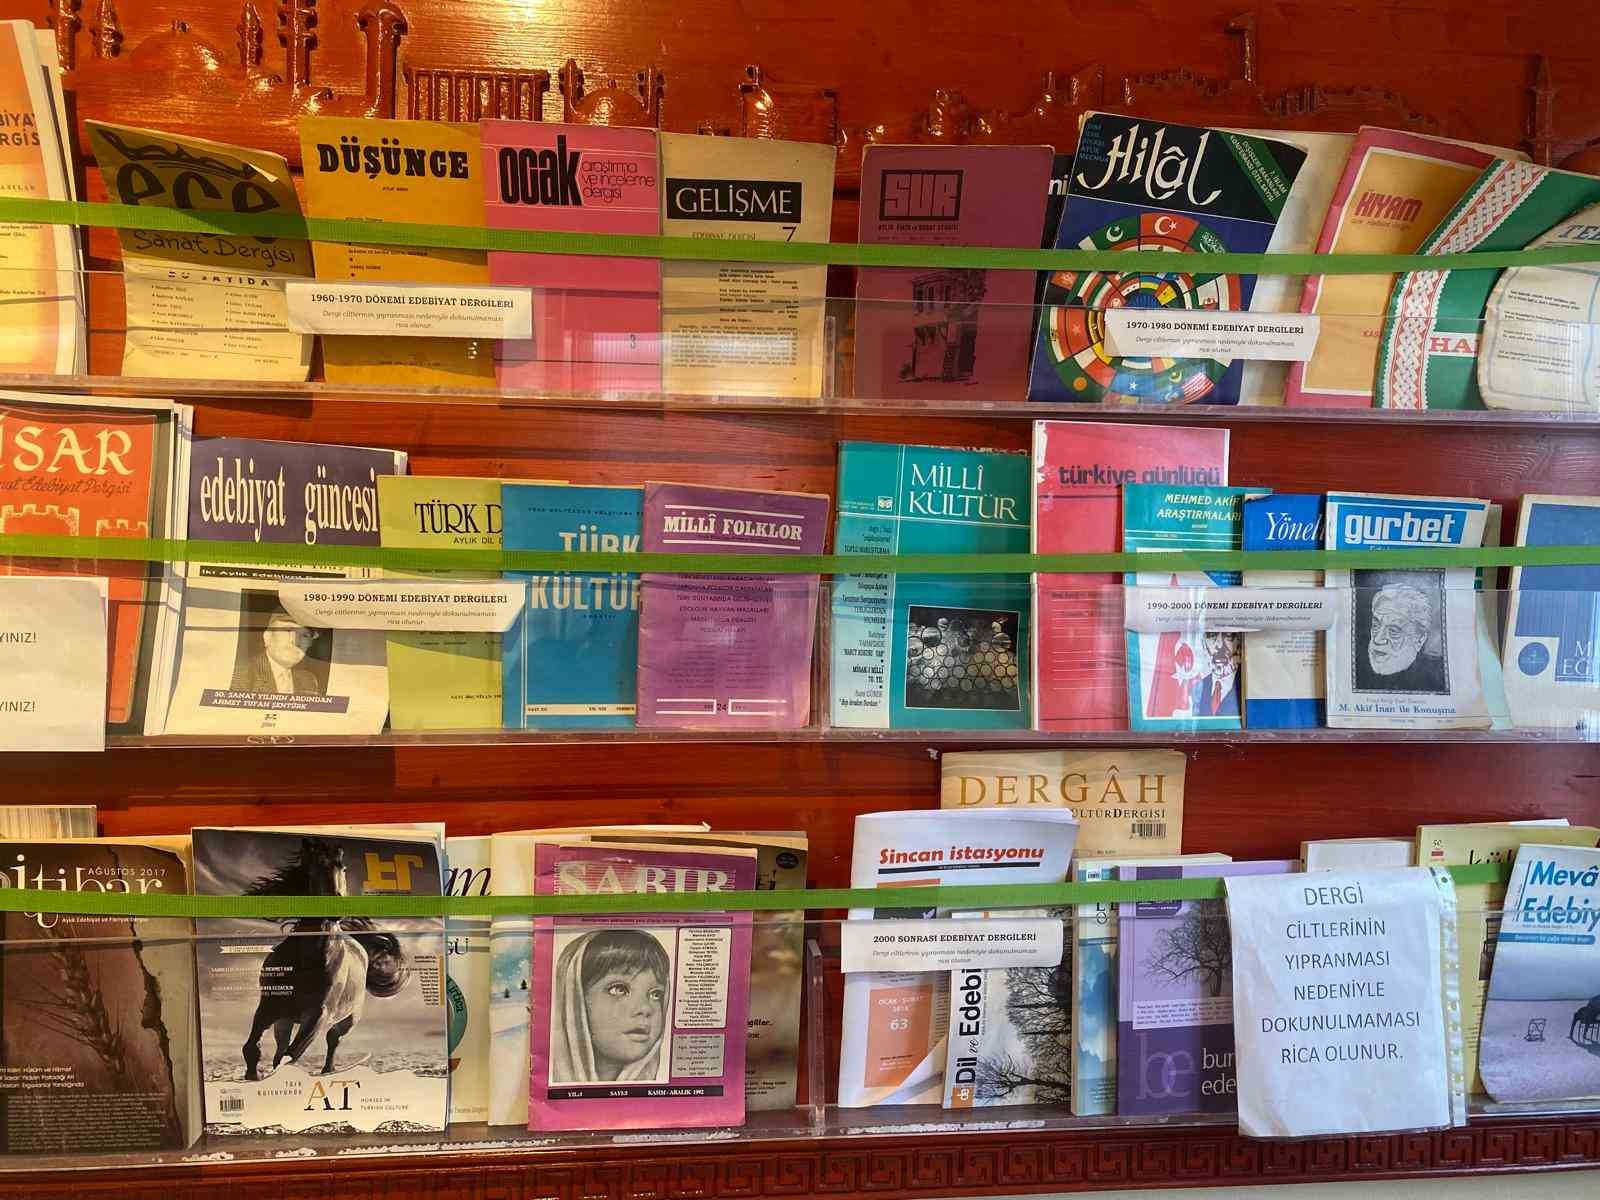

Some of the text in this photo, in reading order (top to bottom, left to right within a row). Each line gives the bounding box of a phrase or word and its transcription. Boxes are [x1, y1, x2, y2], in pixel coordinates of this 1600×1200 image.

[0, 112, 36, 128] BİYA
[316, 135, 470, 180] DÜŞÜNCE
[581, 160, 638, 174] araştırma
[1077, 123, 1222, 206] Hilâl
[499, 134, 583, 206] ocak
[600, 173, 656, 187] inceleme
[582, 187, 622, 204] dergisi
[675, 184, 793, 217] GELİŞME
[782, 226, 797, 242] 7
[135, 229, 297, 269] Sanat Dergisi
[311, 293, 514, 308] 1960-1970 DÖNEMİ EDEBİYAT DERGİLERİ
[1126, 321, 1304, 334] 1970-1980 DÖNEMİ EDEBİYAT DERGİLERİ
[1430, 336, 1478, 353] HA
[911, 461, 984, 491] MİLLÎ
[200, 456, 379, 545] edebiyat güncesi
[909, 488, 1019, 521] KÜLTÜR
[1164, 493, 1212, 506] MEHMED
[414, 499, 480, 535] TÜRK
[663, 510, 803, 541] MİLLÎ FOLKLOR
[1156, 508, 1241, 522] ARAŞTIRMALARI
[1344, 511, 1455, 545] gurbet
[453, 536, 478, 545] AYLIK
[303, 592, 508, 605] 1980-1990 DÖNEMİ EDEBİYAT DERGİLERİ
[1147, 602, 1192, 610] 1990-2000
[1231, 601, 1275, 610] EDEBİYAT
[1276, 602, 1323, 610] DERGİLERİ
[228, 691, 256, 700] SANAT
[957, 764, 1167, 806] DERGÂH
[879, 845, 1045, 865] Sincan istasyonu
[87, 866, 166, 877] AĞUSTOS 2017
[1529, 859, 1600, 887] Mevâ
[1303, 881, 1364, 906] DERGİ
[873, 932, 1036, 943] 2000 SONRASI EDEBİYAT DERGİLERİ
[1286, 917, 1386, 940] CİLTLERİNİN
[1284, 950, 1390, 971] YIPRANMASI
[1294, 979, 1386, 1001] NEDENİYLE
[1261, 1010, 1421, 1034] DOKUNULMAMASI
[1281, 1042, 1404, 1064] RİCA OLUNUR.
[955, 1056, 978, 1085] Dil
[304, 1080, 361, 1111] AT
